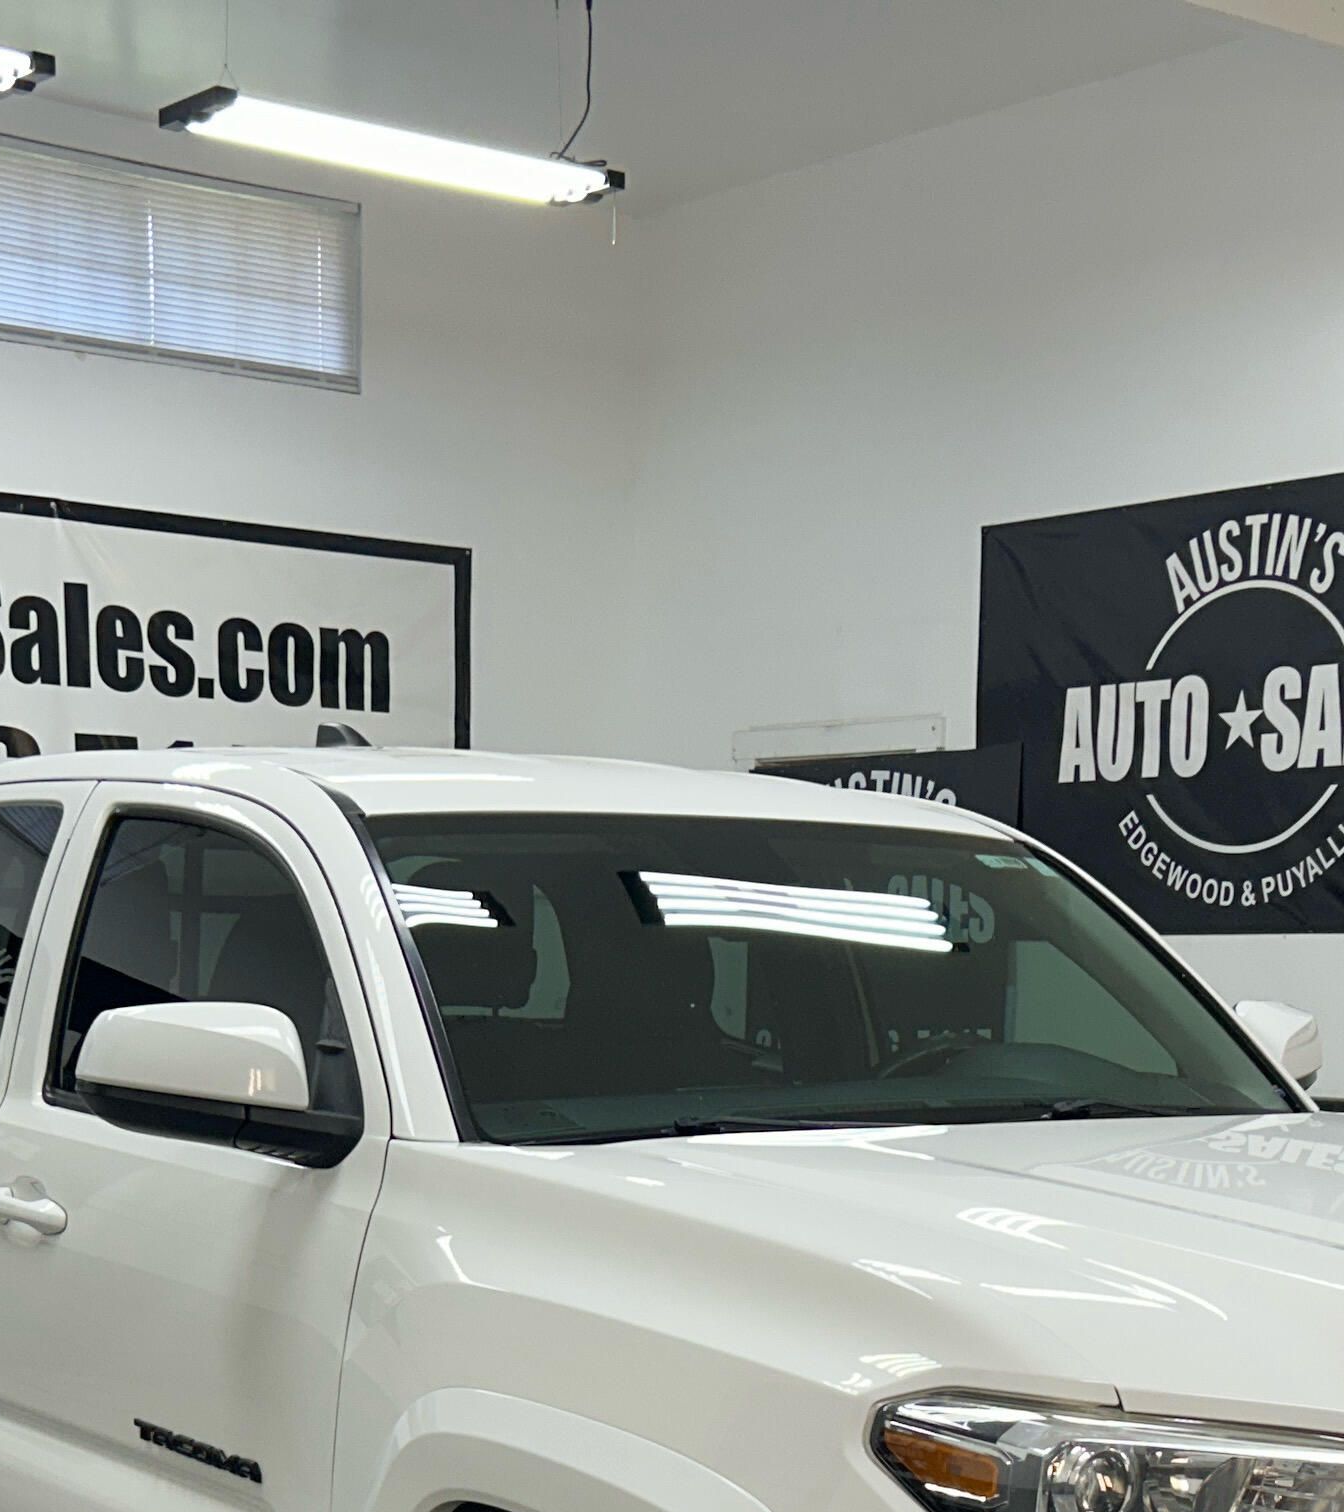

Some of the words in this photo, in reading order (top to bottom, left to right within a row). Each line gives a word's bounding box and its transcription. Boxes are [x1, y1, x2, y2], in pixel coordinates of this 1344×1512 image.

[1058, 674, 1209, 784] AUTO
[1118, 810, 1235, 908] EDGEWOOD
[1241, 880, 1257, 907] &
